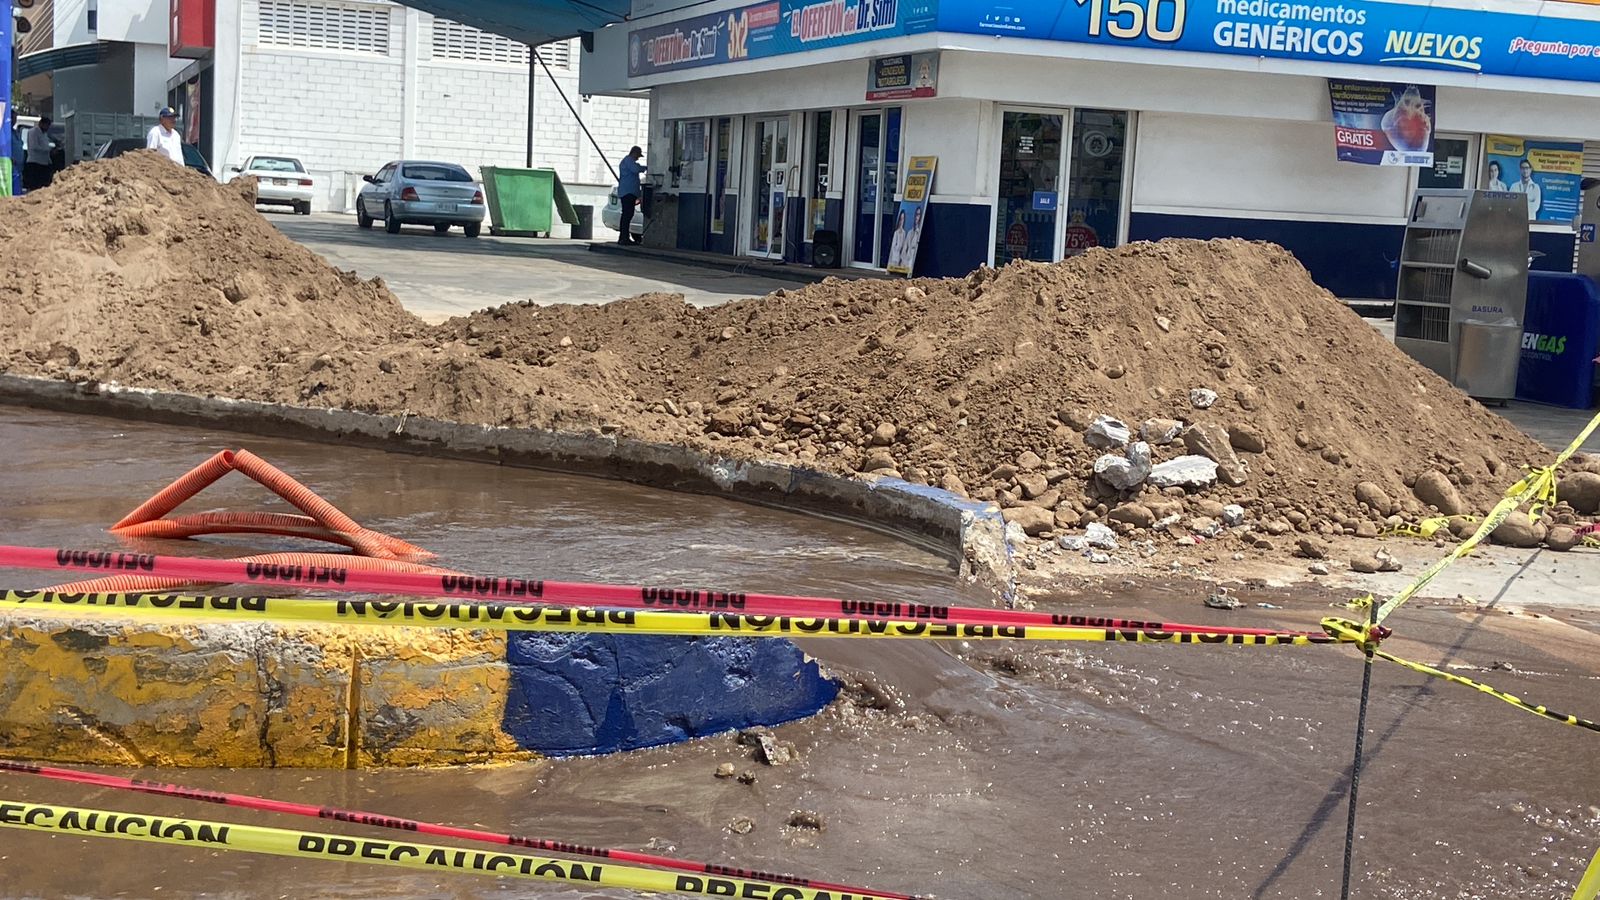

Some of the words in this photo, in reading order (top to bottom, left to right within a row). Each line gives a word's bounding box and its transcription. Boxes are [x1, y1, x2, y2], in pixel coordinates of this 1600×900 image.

[801, 0, 844, 42] OFERTÓN
[844, 5, 857, 35] del
[857, 0, 870, 30] Dr.
[871, 0, 898, 31] Simi
[1216, 0, 1367, 25] medicamentos
[728, 11, 748, 60] 3x2
[1213, 20, 1364, 57] GENÉRICOS
[1384, 30, 1483, 60] NUEVOS
[1509, 36, 1569, 56] ¡Pregunta
[1568, 44, 1591, 59] por
[1337, 129, 1374, 147] GRATIS
[1483, 191, 1519, 200] SERVICIO
[1472, 305, 1504, 314] BASURA
